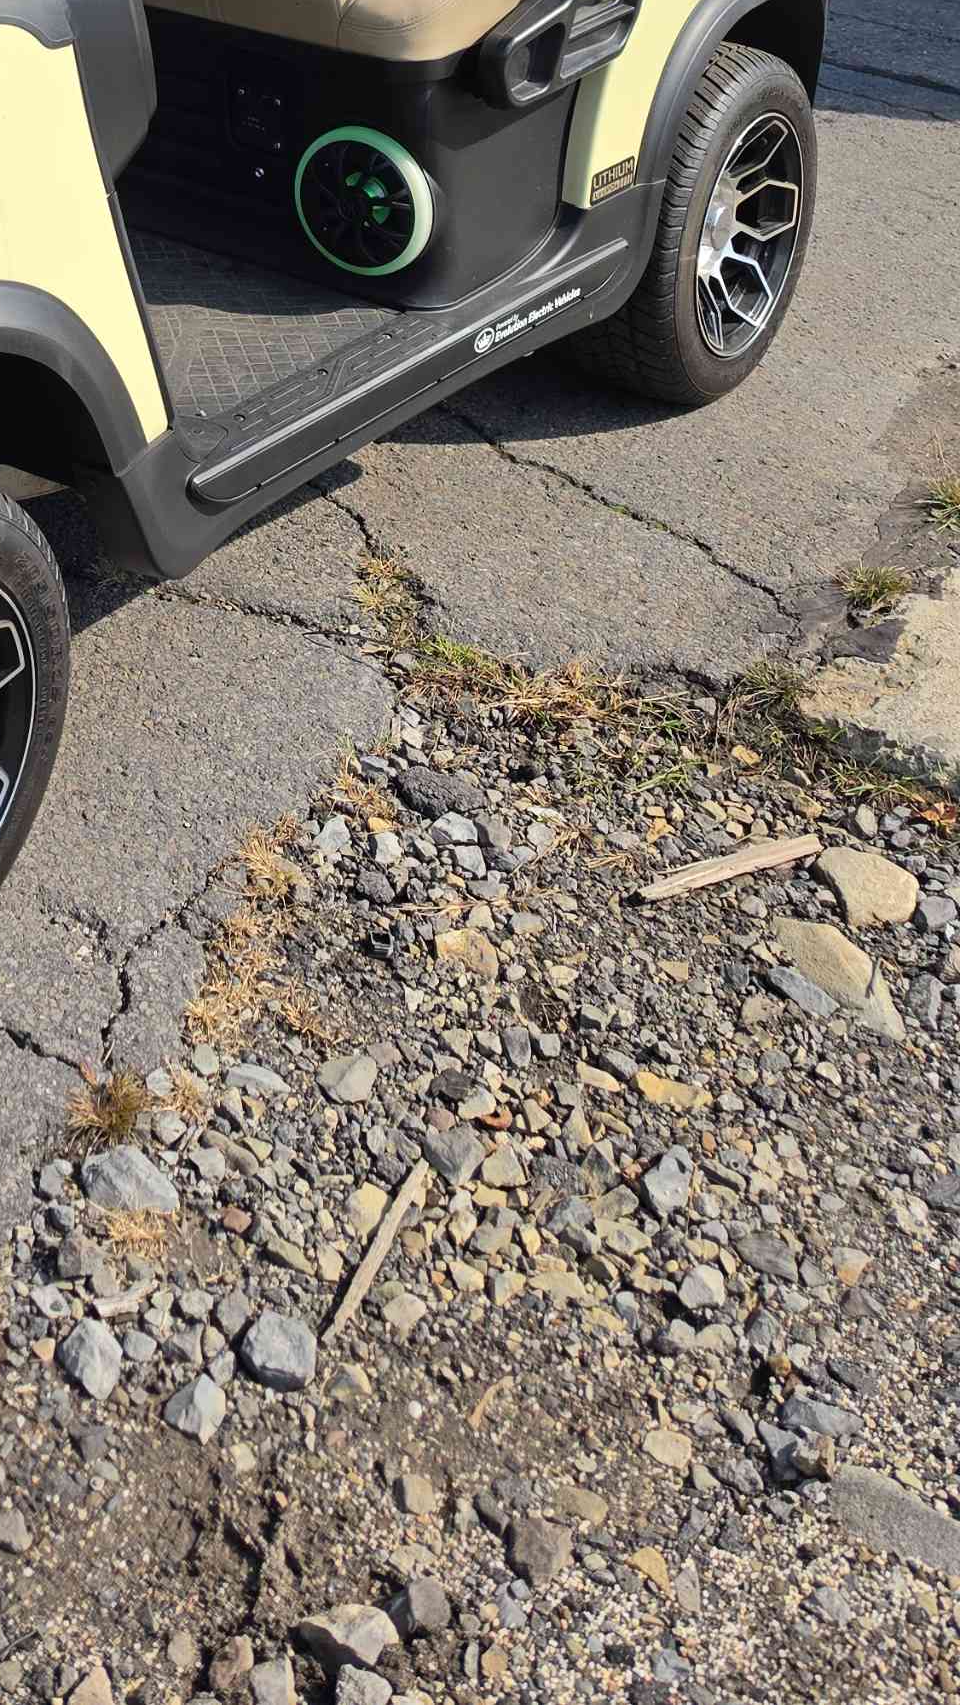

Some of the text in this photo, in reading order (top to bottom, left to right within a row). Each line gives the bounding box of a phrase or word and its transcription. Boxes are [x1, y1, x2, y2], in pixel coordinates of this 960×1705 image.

[593, 158, 633, 188] LITHIUM
[495, 317, 528, 343] Evolution
[528, 302, 554, 324] Electric
